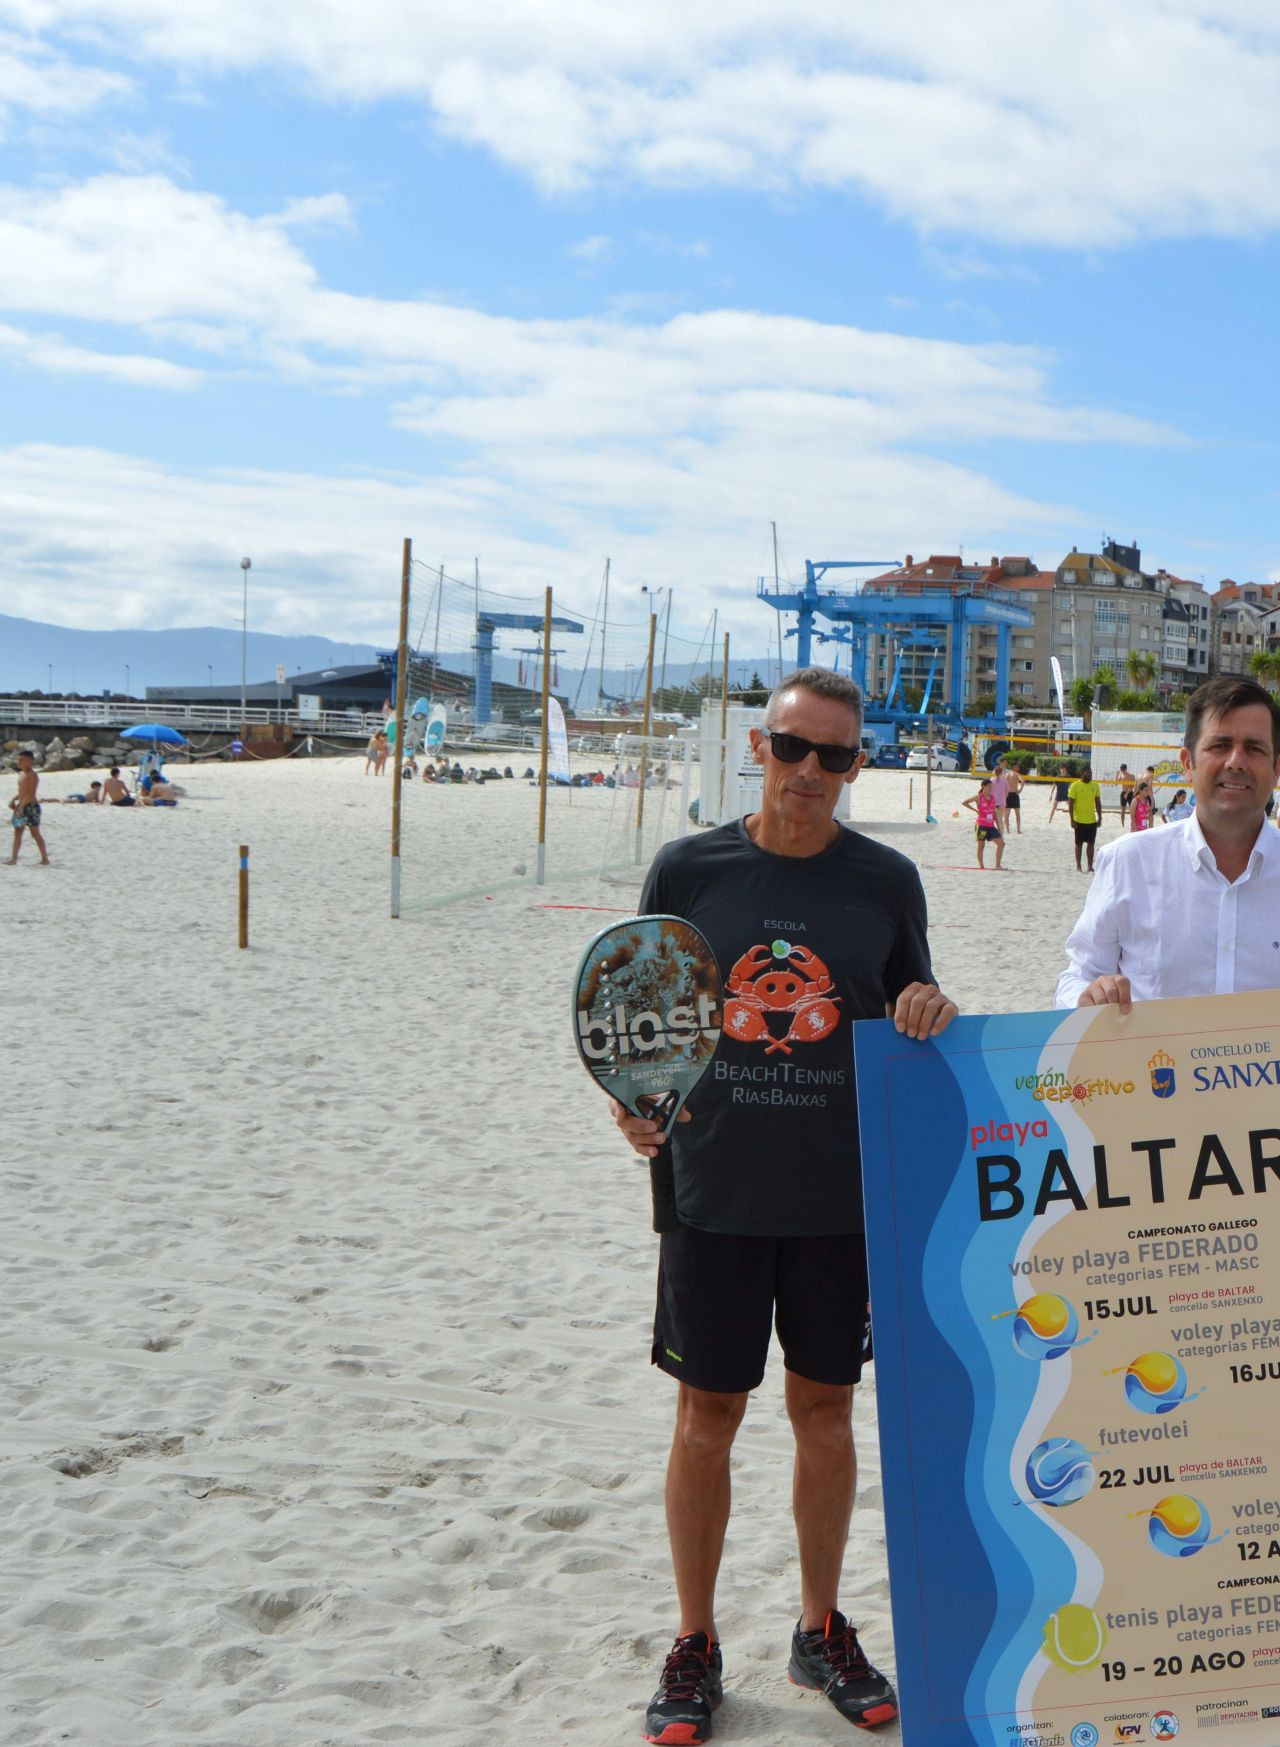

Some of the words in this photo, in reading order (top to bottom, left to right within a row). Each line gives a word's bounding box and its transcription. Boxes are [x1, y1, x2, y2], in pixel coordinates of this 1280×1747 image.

[764, 920, 806, 931] ESCOLA
[578, 994, 721, 1059] blast
[1191, 1044, 1251, 1060] CONCELLO
[1254, 1042, 1271, 1055] DE
[1015, 1068, 1065, 1090] verán
[1033, 1079, 1136, 1103] deportivo
[971, 1120, 1048, 1151] playa
[1128, 1223, 1206, 1239] CAMPEONATO
[1208, 1219, 1258, 1232] GALLEGO
[1009, 1256, 1064, 1276] voley
[1073, 1249, 1129, 1273] playa
[1138, 1233, 1258, 1262] FEDERADO
[1086, 1267, 1163, 1286] categorias
[1169, 1263, 1200, 1278] FEM
[1216, 1257, 1259, 1272] MASC
[1169, 1291, 1198, 1304] playa
[1202, 1289, 1215, 1298] de
[1218, 1286, 1255, 1297] BALTAR
[1170, 1303, 1208, 1313] concello
[1211, 1296, 1263, 1309] SANXENXO
[1084, 1296, 1157, 1320] 15JUL
[1171, 1323, 1223, 1342] voley
[1178, 1341, 1247, 1358] categorias
[1253, 1337, 1279, 1350] FEM
[1099, 1420, 1188, 1446] futevolei
[1179, 1461, 1208, 1475] playa
[1211, 1459, 1223, 1469] de
[1226, 1456, 1263, 1467] BALTAR
[1180, 1471, 1216, 1482] concello
[1218, 1465, 1267, 1479] SANXENXO
[1100, 1469, 1126, 1489] 22
[1133, 1465, 1175, 1485] JUL
[1238, 1541, 1261, 1561] 12
[1106, 1608, 1158, 1628] tenis
[1167, 1604, 1222, 1628] playa
[1177, 1624, 1251, 1642] categorias
[1252, 1646, 1280, 1658] playa
[1102, 1662, 1126, 1681] 19
[1154, 1656, 1182, 1676] 20
[1190, 1651, 1244, 1673] AGO
[1196, 1699, 1248, 1713] patrocinan
[1118, 1725, 1141, 1736] VPV
